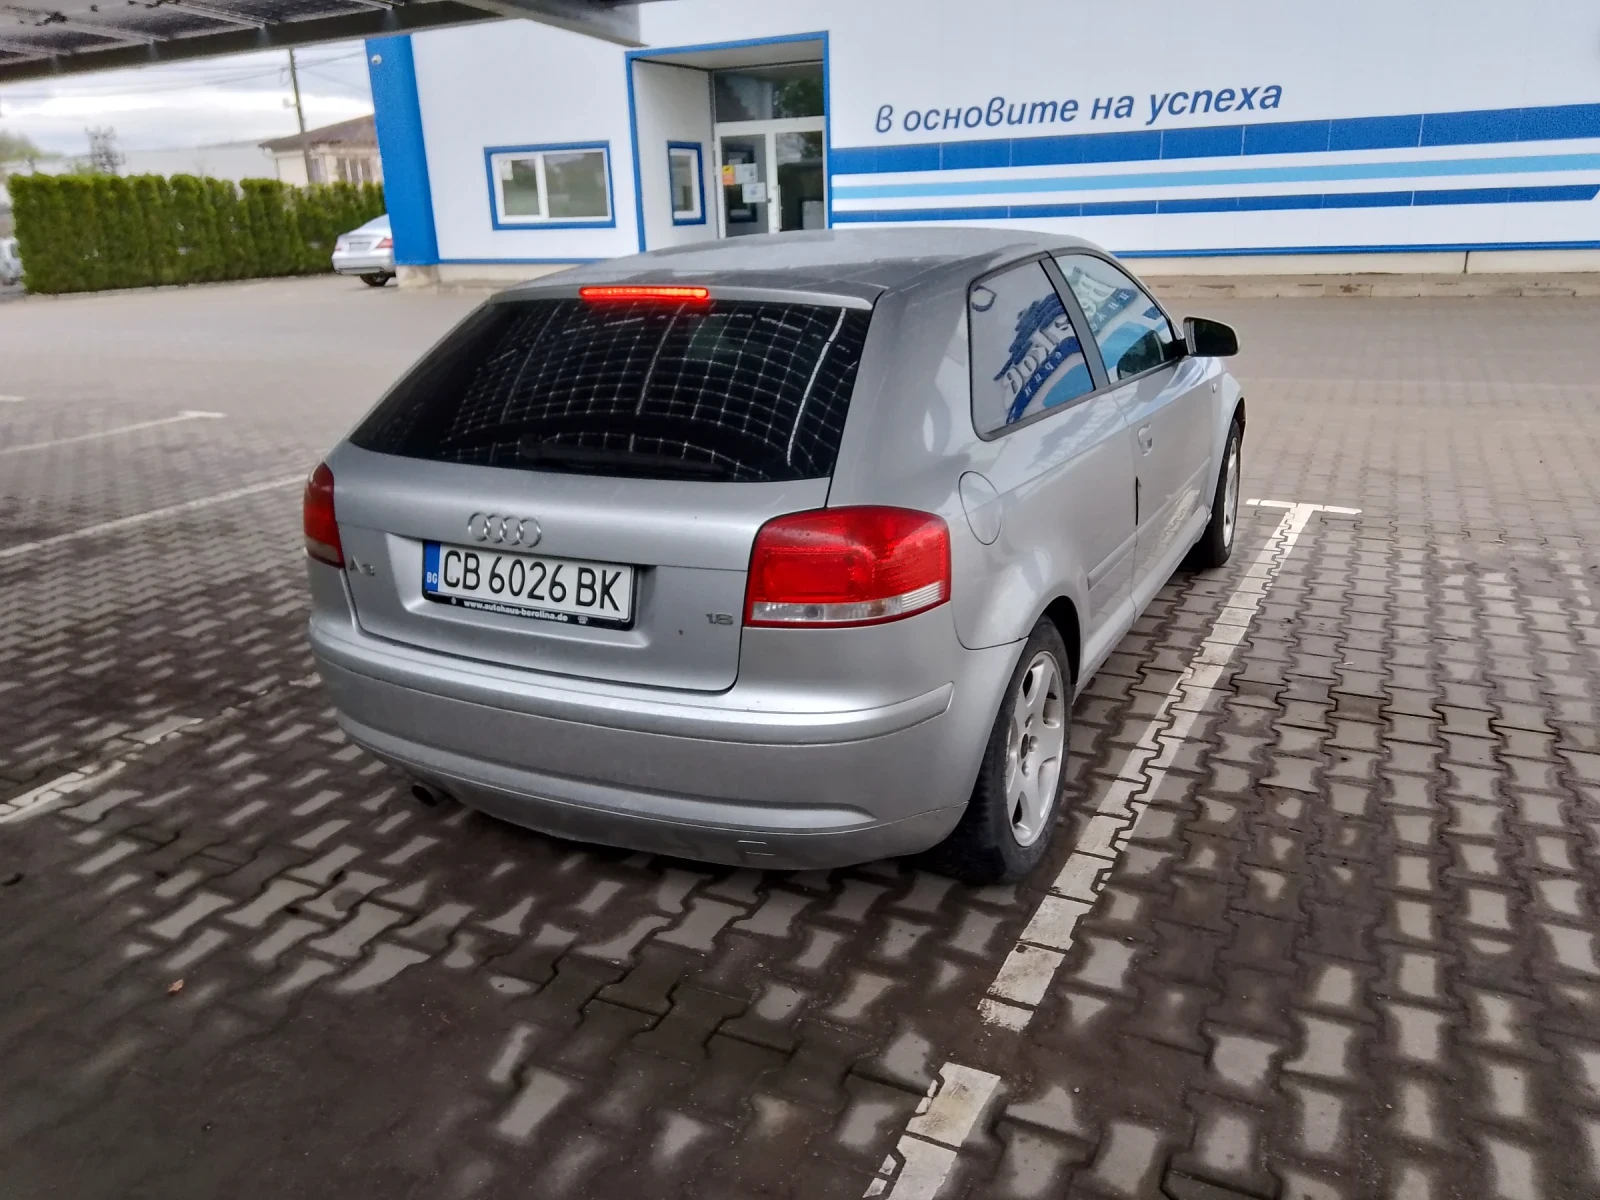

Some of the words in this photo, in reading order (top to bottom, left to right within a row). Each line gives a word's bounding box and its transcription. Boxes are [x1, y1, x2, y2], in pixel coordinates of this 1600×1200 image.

[903, 96, 1079, 132] основите
[1090, 94, 1135, 120] на
[1145, 84, 1282, 126] успеха
[426, 571, 438, 584] BG
[443, 550, 481, 591] CB
[488, 556, 567, 603] 6026
[575, 566, 622, 612] BK
[463, 599, 569, 622] www.autohaus-berolina.de
